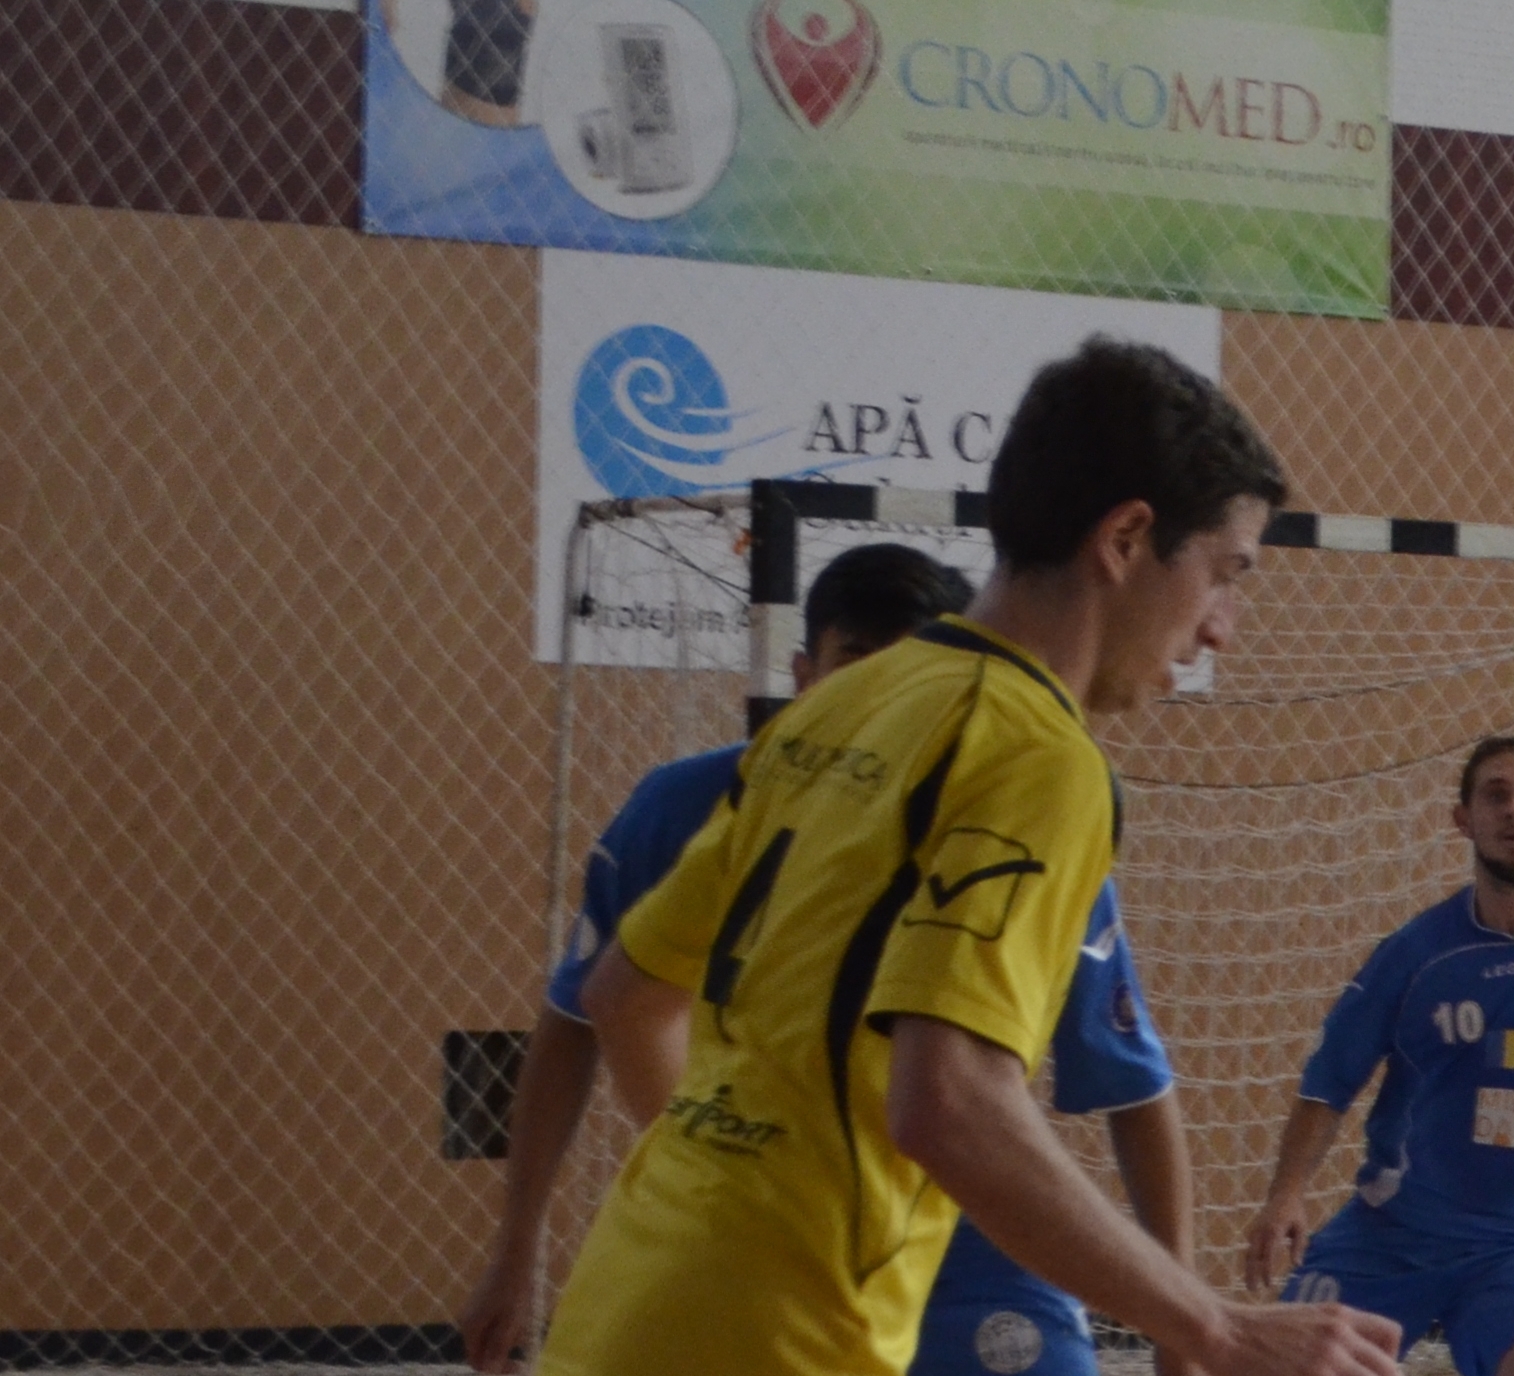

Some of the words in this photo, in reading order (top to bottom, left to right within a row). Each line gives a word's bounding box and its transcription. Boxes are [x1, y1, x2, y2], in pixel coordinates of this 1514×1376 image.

[800, 393, 934, 461] APĂ
[949, 410, 1002, 466] C
[1431, 999, 1486, 1046] 10
